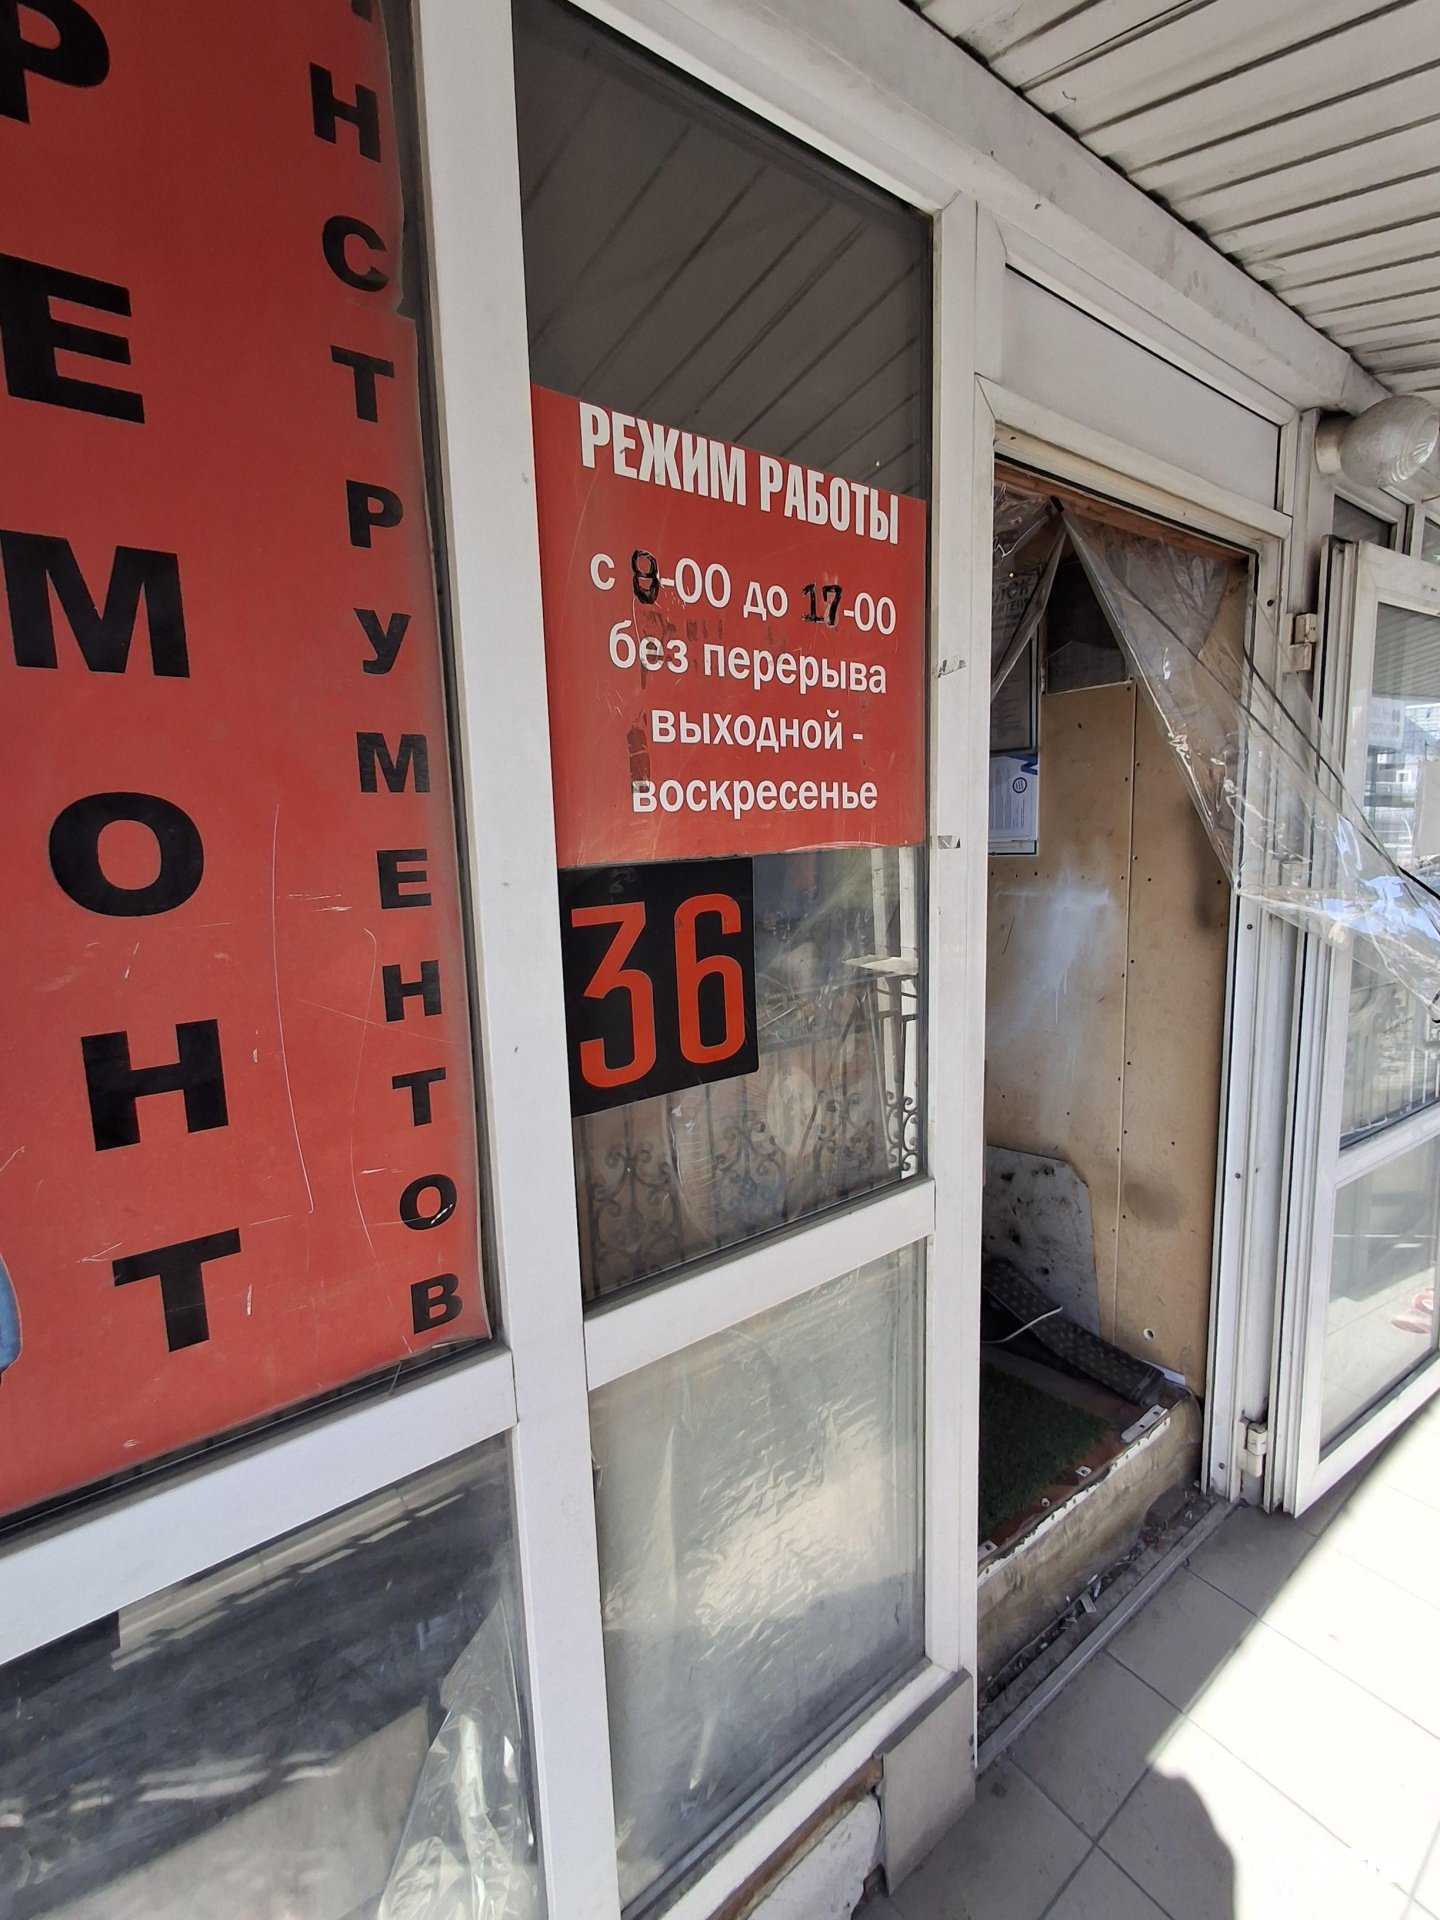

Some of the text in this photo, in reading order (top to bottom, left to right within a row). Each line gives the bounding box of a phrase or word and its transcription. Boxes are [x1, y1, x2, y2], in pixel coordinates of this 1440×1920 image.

[579, 401, 899, 545] РЕЖИМ РАБОТЫ
[609, 619, 887, 695] без перерыва
[743, 581, 789, 621] до
[801, 583, 897, 636] 17-00
[0, 0, 242, 1353] РЕМОНТ
[309, 0, 463, 1335] НСТРУМЕНТОВ
[651, 709, 843, 753] выходной
[632, 776, 878, 819] воскресенье
[570, 892, 747, 1089] 36
